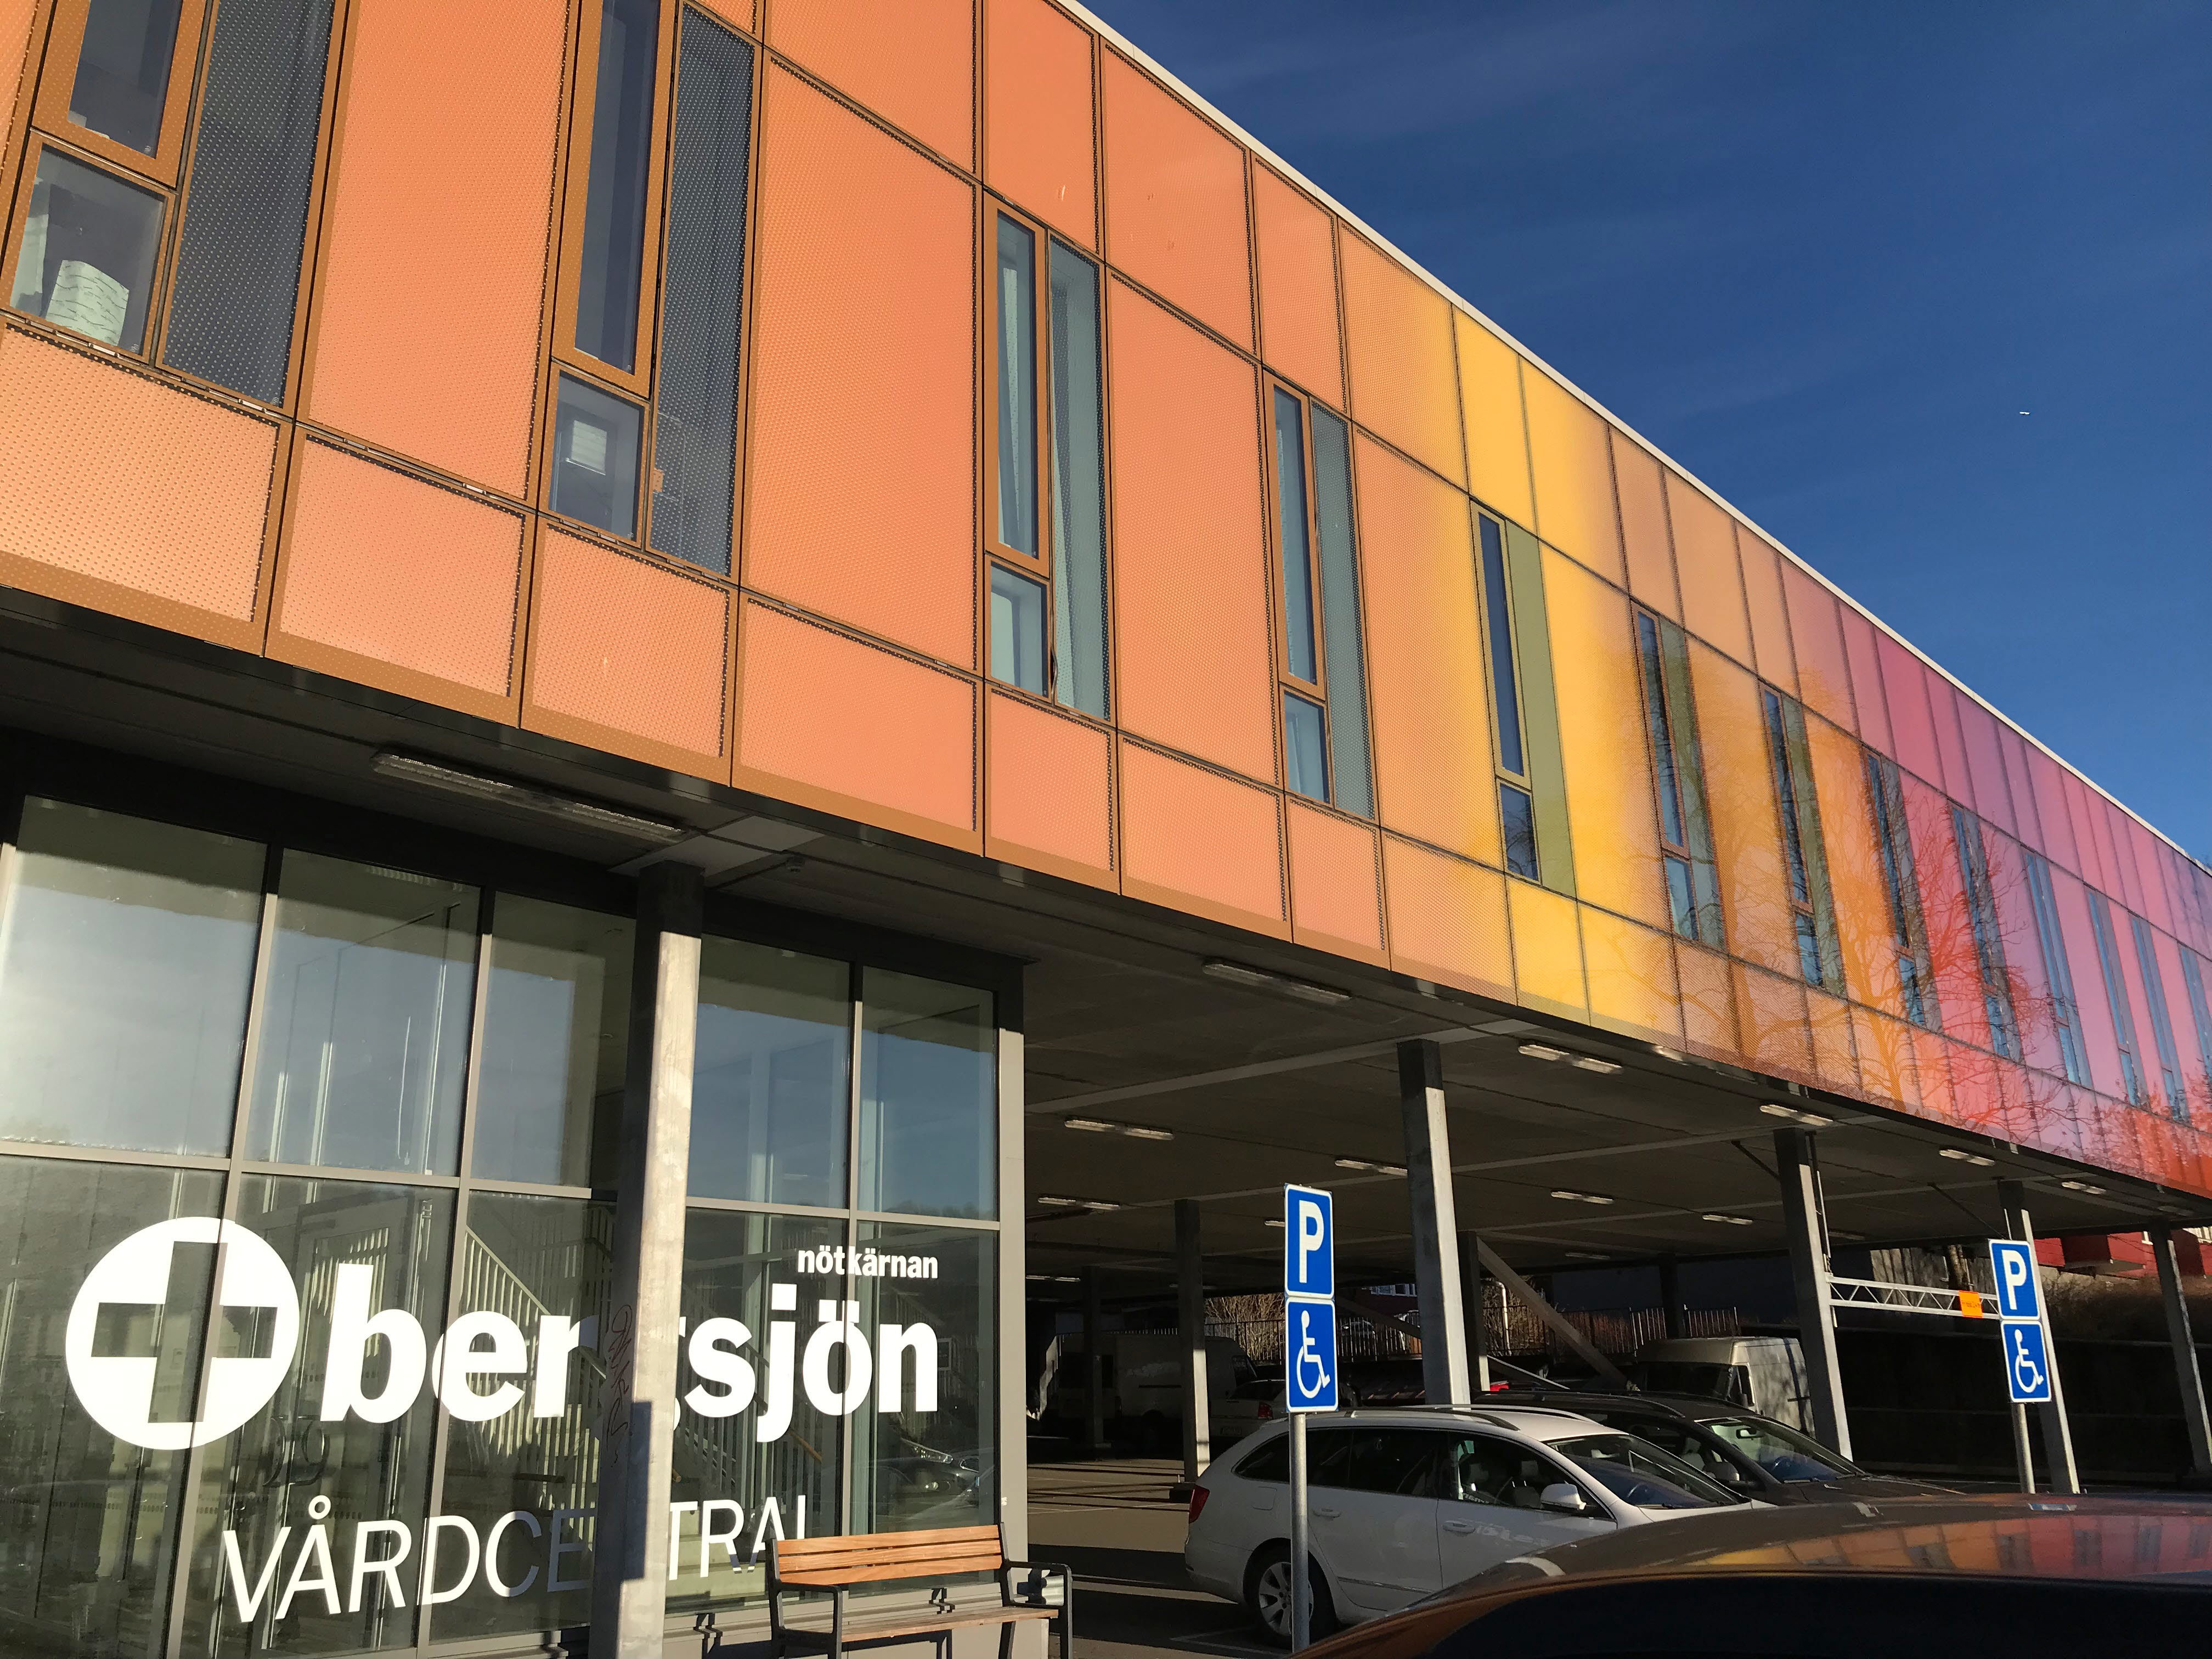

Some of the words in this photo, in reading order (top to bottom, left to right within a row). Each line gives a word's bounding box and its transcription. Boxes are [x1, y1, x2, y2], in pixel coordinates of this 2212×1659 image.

[798, 1245, 938, 1278] nötkärnan
[1299, 1200, 1324, 1283] P
[2002, 1250, 2027, 1310] P
[321, 1264, 938, 1443] bersjön
